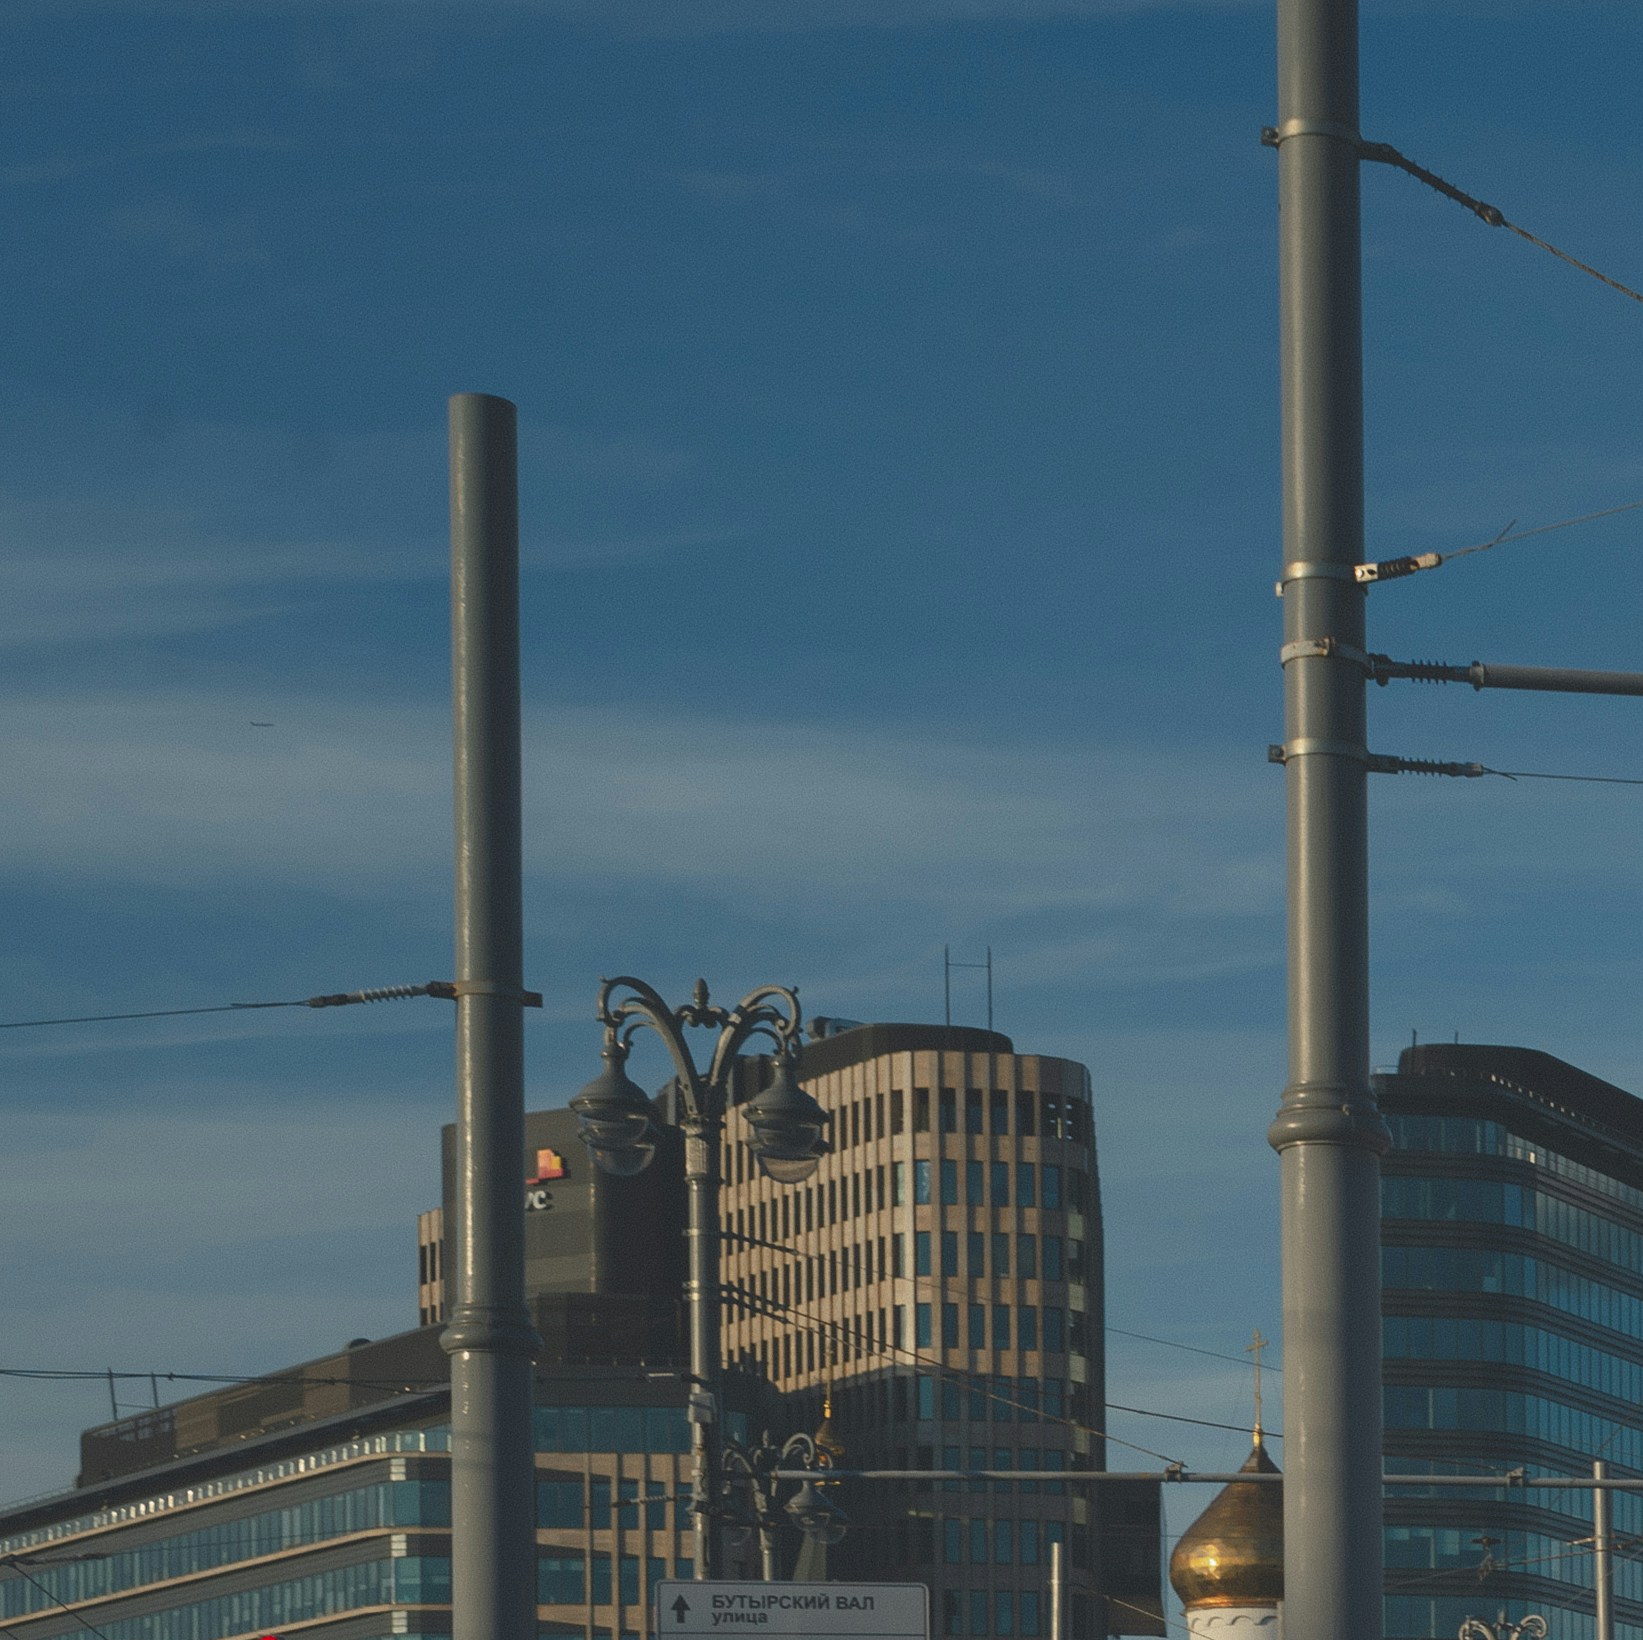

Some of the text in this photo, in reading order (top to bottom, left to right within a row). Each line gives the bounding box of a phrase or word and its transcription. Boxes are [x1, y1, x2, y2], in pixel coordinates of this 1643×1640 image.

[712, 1594, 875, 1611] БУТЫРСКИЙ ВАЛ
[712, 1612, 768, 1626] улица
